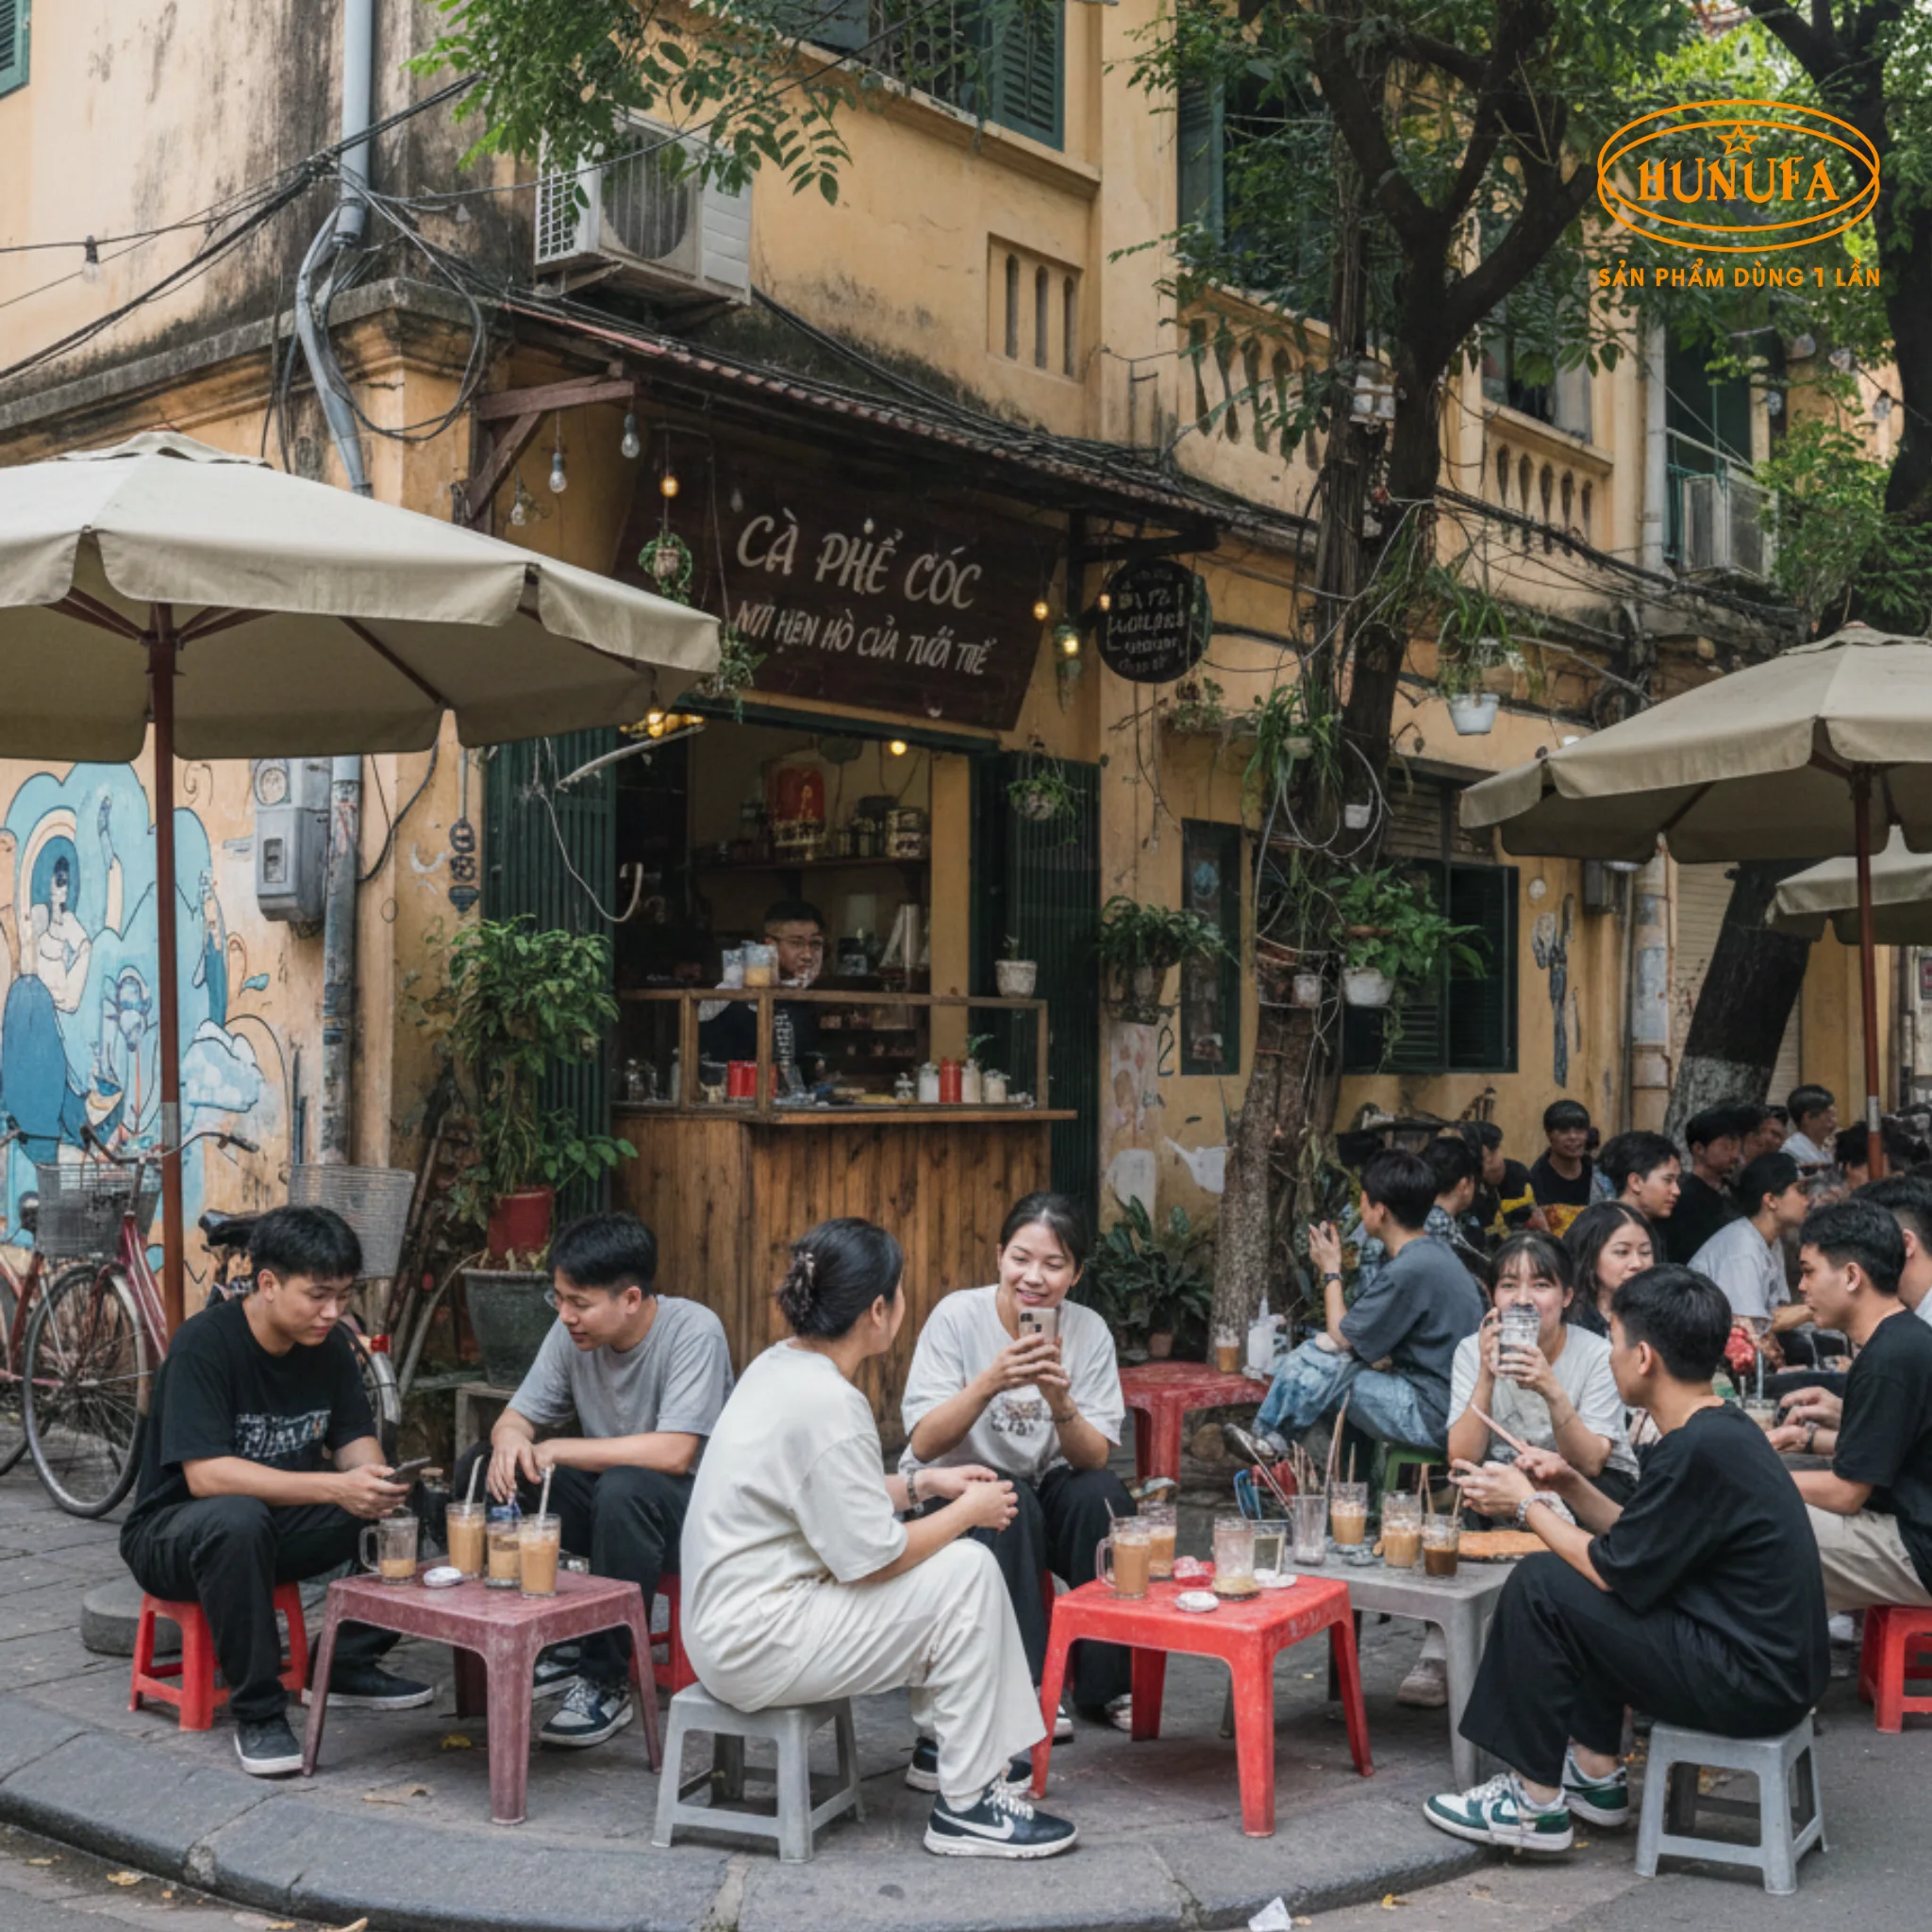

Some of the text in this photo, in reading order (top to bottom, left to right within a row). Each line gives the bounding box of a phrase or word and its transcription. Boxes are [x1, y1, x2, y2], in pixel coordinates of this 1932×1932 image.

[737, 507, 799, 575] CÀ
[904, 545, 983, 609] CÓC
[820, 608, 856, 653] HÒ
